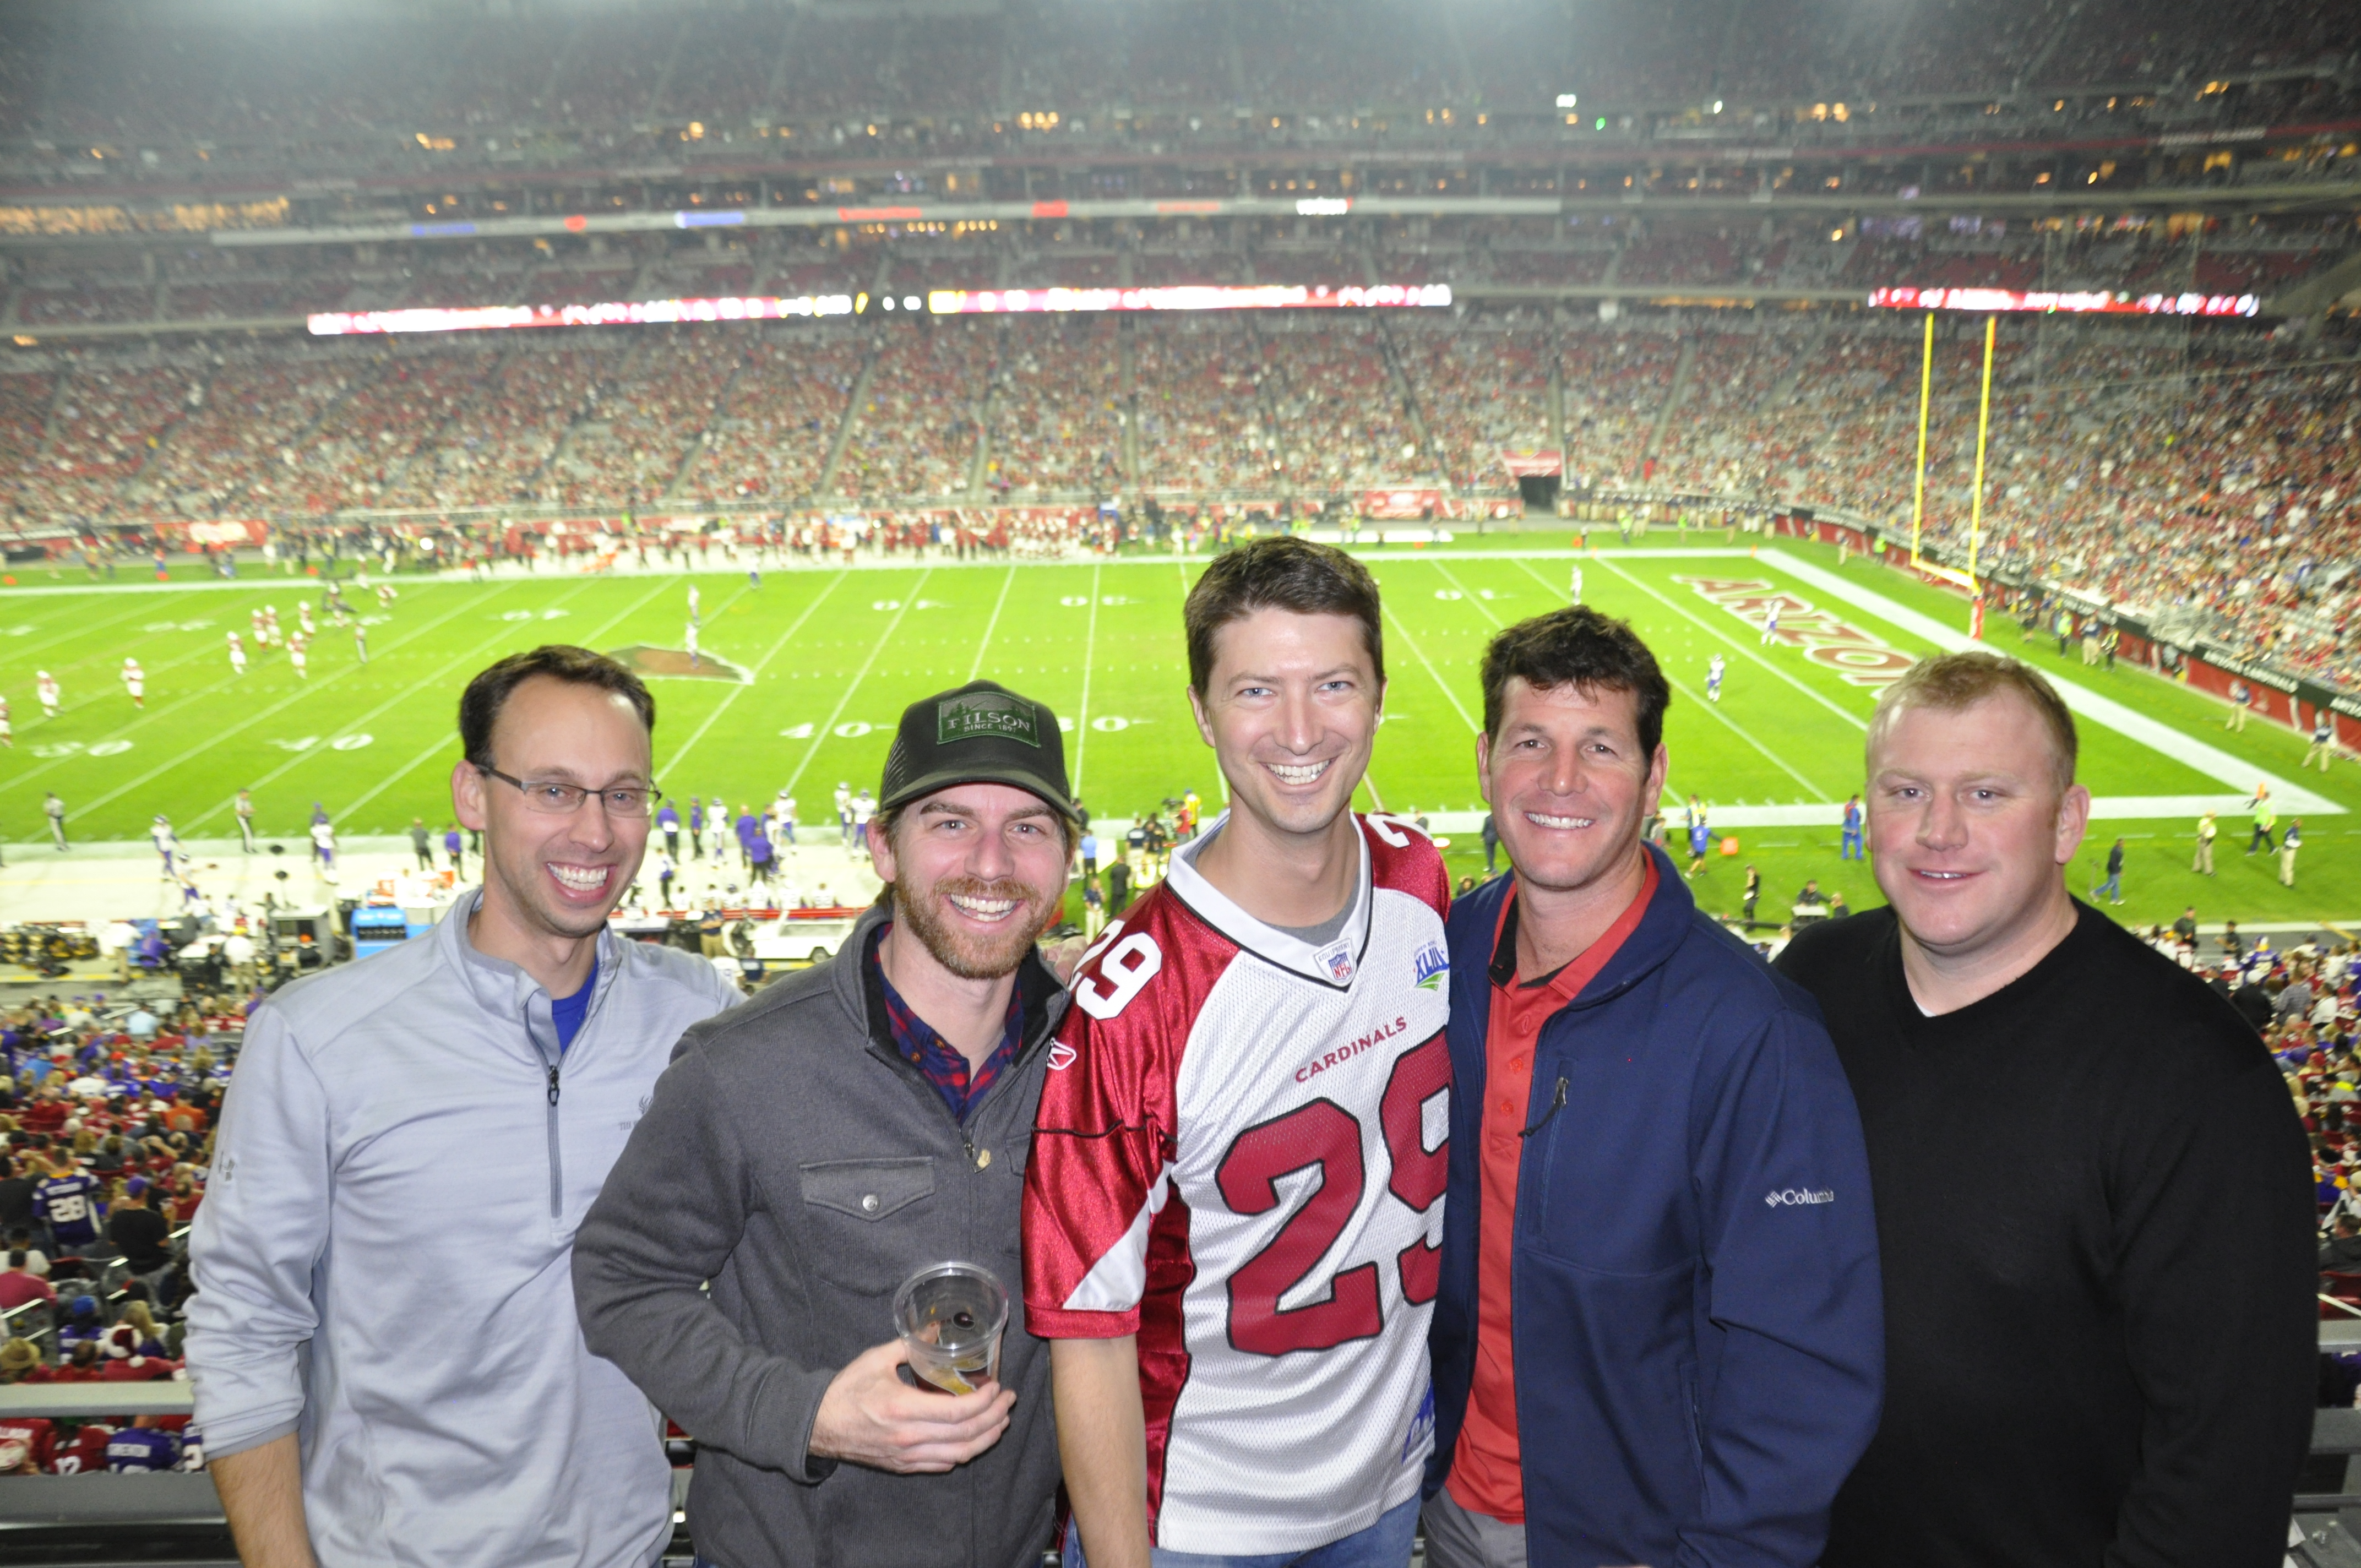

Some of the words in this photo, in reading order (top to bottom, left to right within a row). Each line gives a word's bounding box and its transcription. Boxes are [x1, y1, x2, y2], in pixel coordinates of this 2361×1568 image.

[1669, 574, 1917, 700] ARIZO
[947, 712, 1031, 732] FILSON
[964, 723, 993, 732] SINCE
[1318, 942, 1350, 962] EQUIPMENT
[1068, 919, 1162, 1020] 29
[1334, 962, 1351, 979] NFL
[1295, 1016, 1407, 1083] CARDINALS
[1215, 1025, 1454, 1358] 29
[47, 1195, 87, 1222] 28
